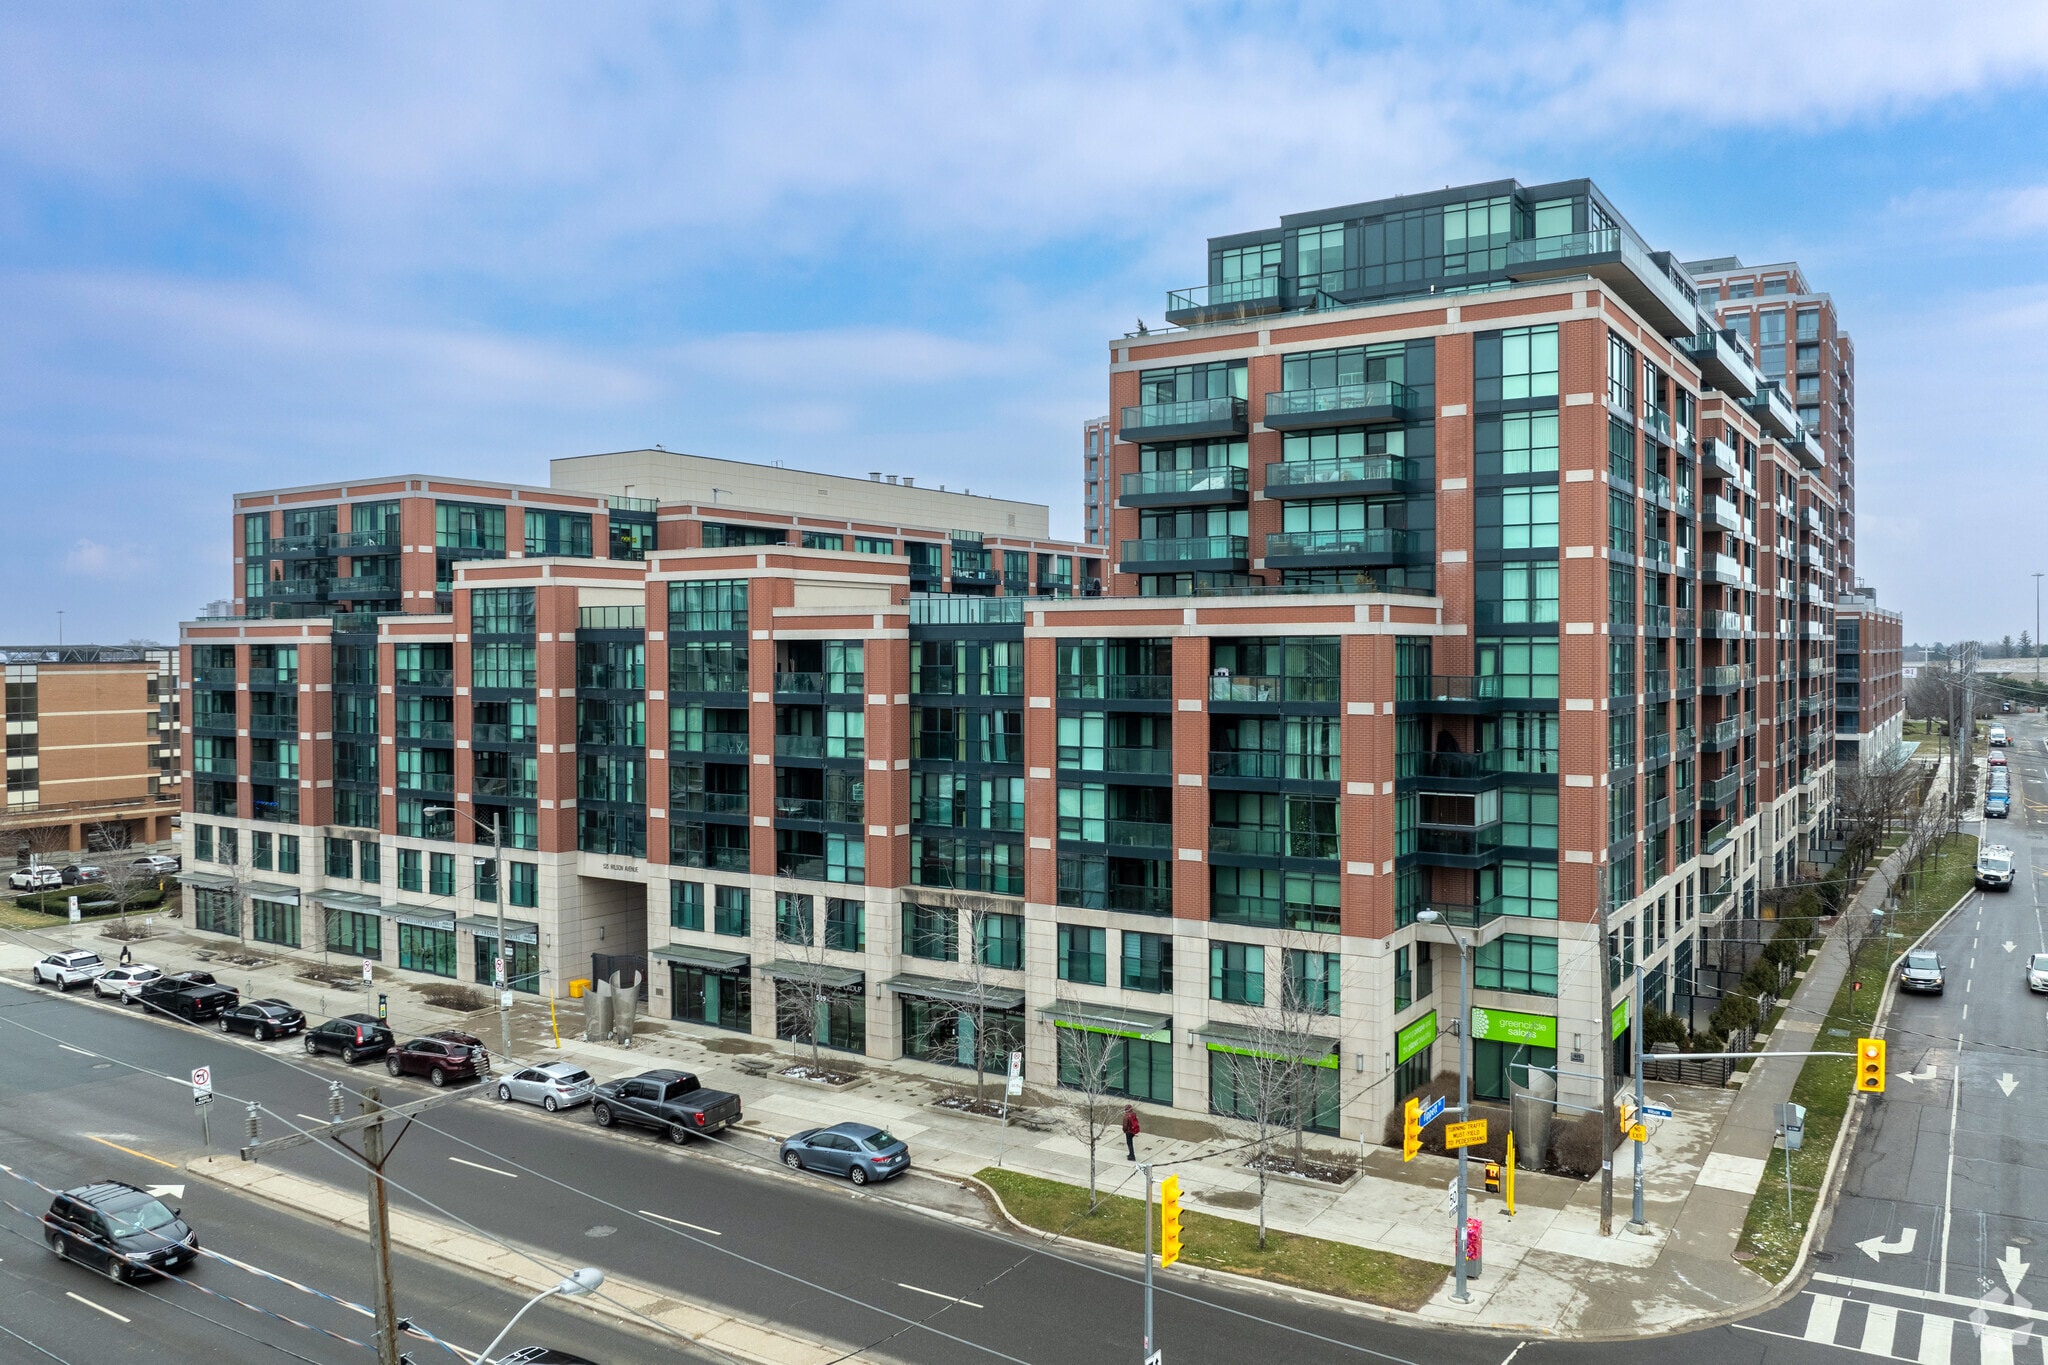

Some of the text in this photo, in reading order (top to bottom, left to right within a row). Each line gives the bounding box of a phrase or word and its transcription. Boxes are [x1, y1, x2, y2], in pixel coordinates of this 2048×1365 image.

[625, 865, 639, 873] AVENUE
[1499, 1019, 1547, 1032] greencircle
[1507, 1027, 1537, 1039] salons
[1423, 1103, 1438, 1122] Tippett
[1448, 1121, 1486, 1133] TURNING TRAFFIC
[1456, 1135, 1486, 1145] PEDESTRIANS
[1450, 1190, 1457, 1207] 50
